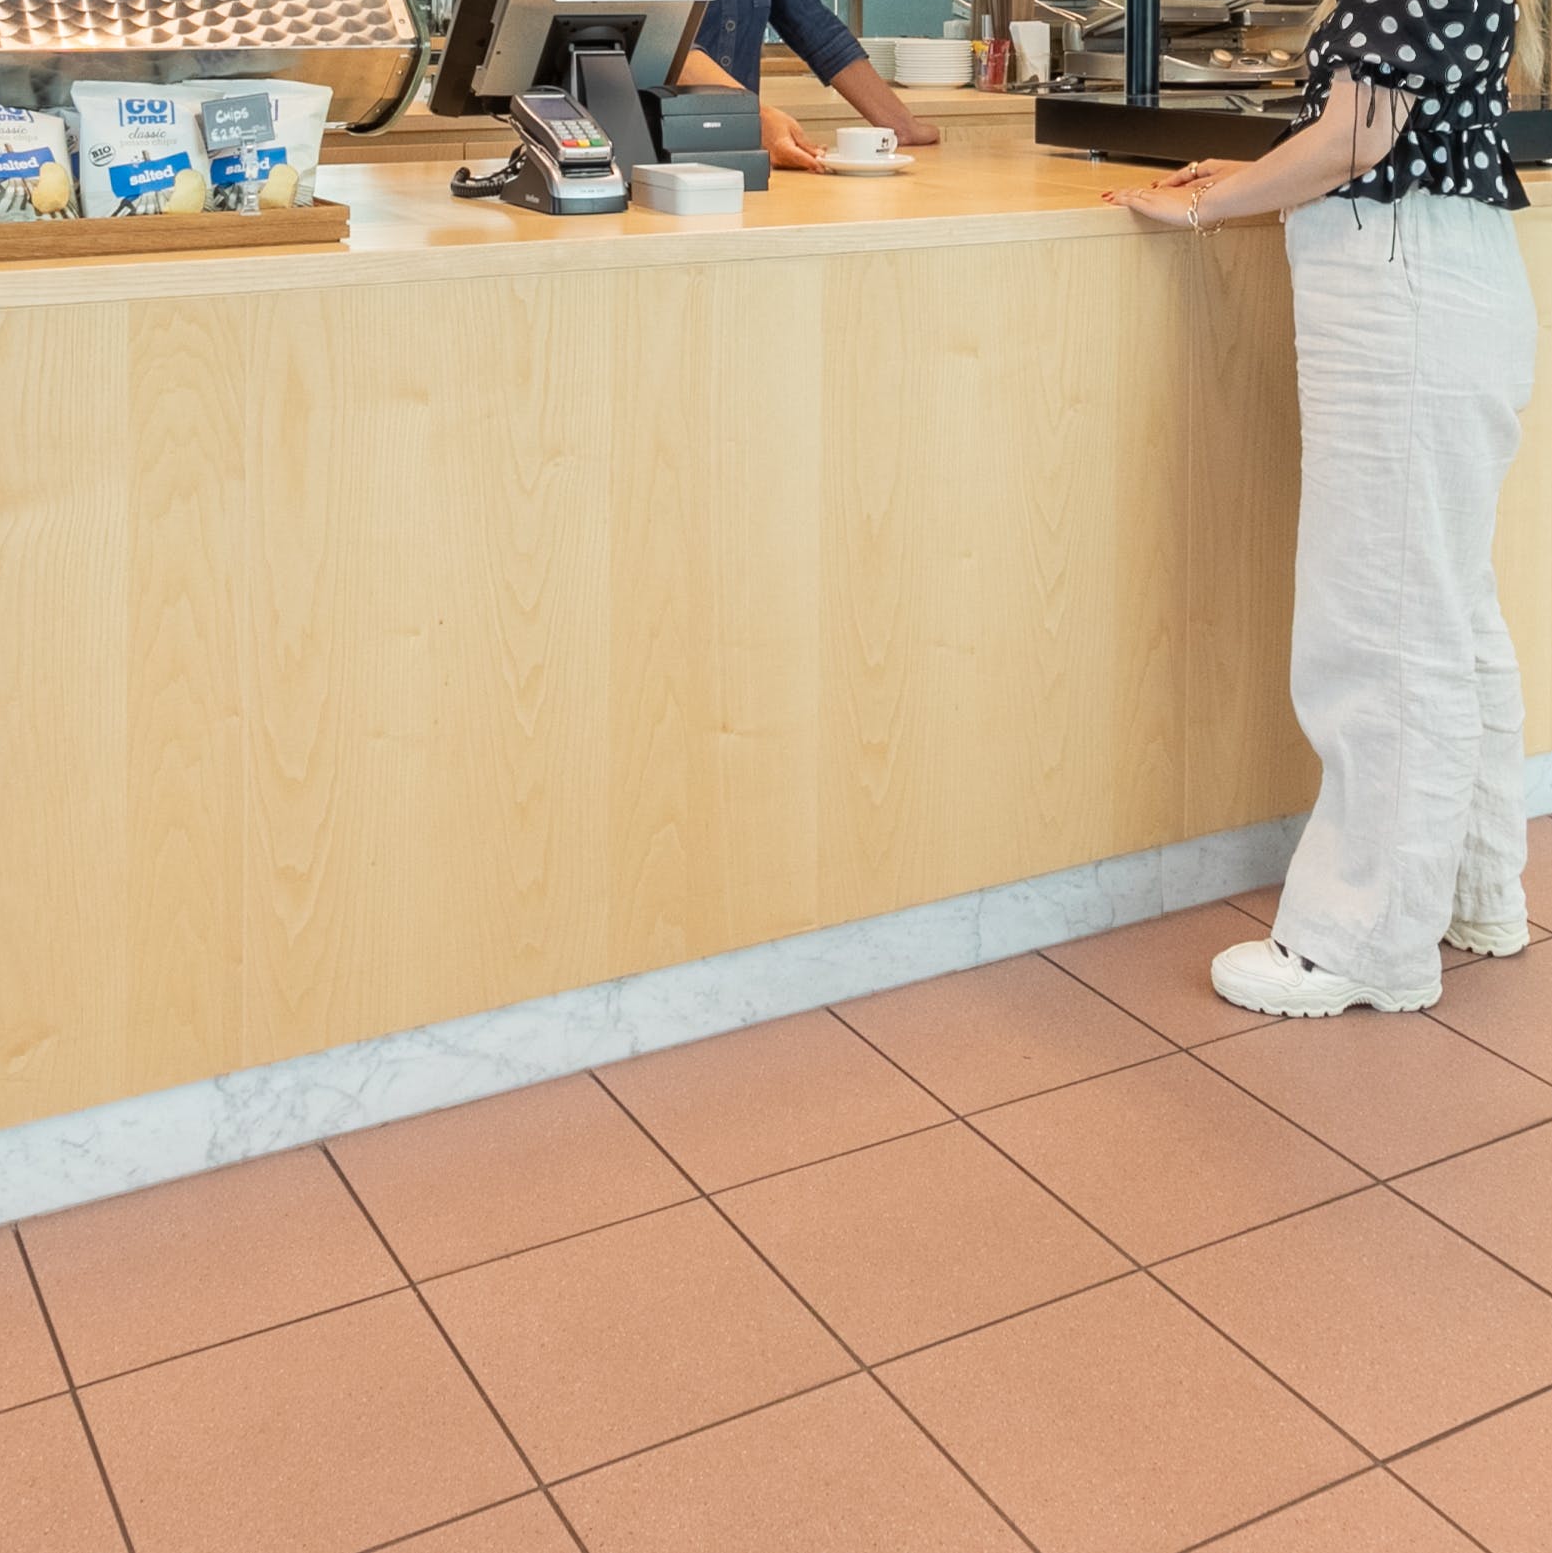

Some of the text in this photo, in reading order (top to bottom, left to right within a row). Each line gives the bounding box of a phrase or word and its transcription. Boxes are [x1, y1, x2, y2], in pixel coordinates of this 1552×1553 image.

[125, 99, 167, 114] GO
[128, 115, 167, 124] PURE
[128, 127, 167, 139] classic
[91, 145, 112, 159] BIO
[129, 165, 175, 186] salted
